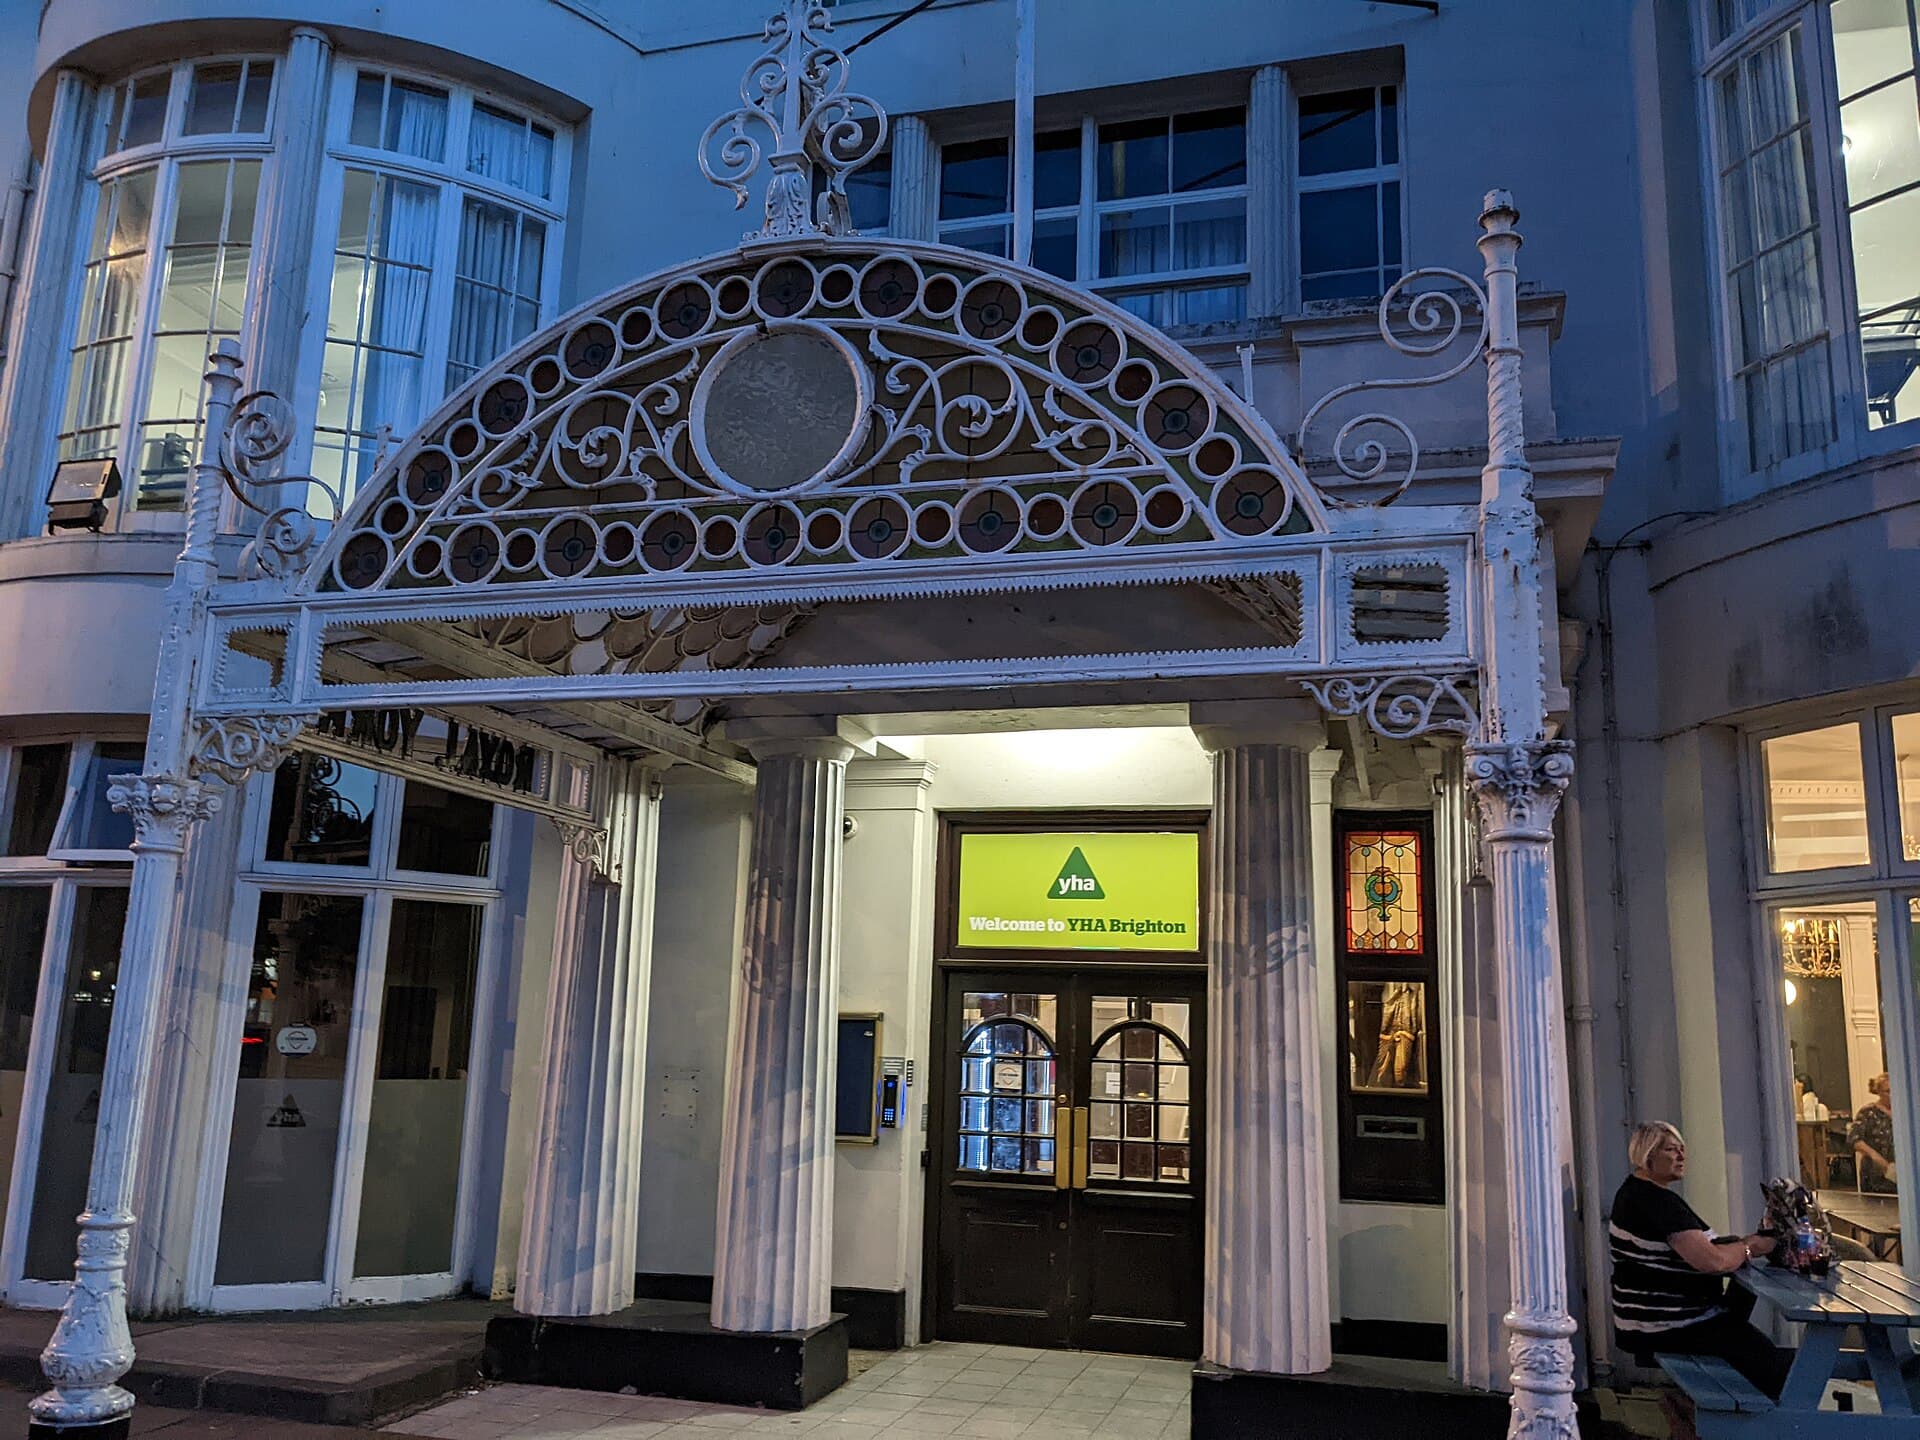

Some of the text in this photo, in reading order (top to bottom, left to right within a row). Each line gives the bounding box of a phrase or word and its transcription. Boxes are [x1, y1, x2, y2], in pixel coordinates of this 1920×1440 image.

[1058, 875, 1095, 895] yha
[969, 917, 1186, 936] Welcome to YHA Brighton
